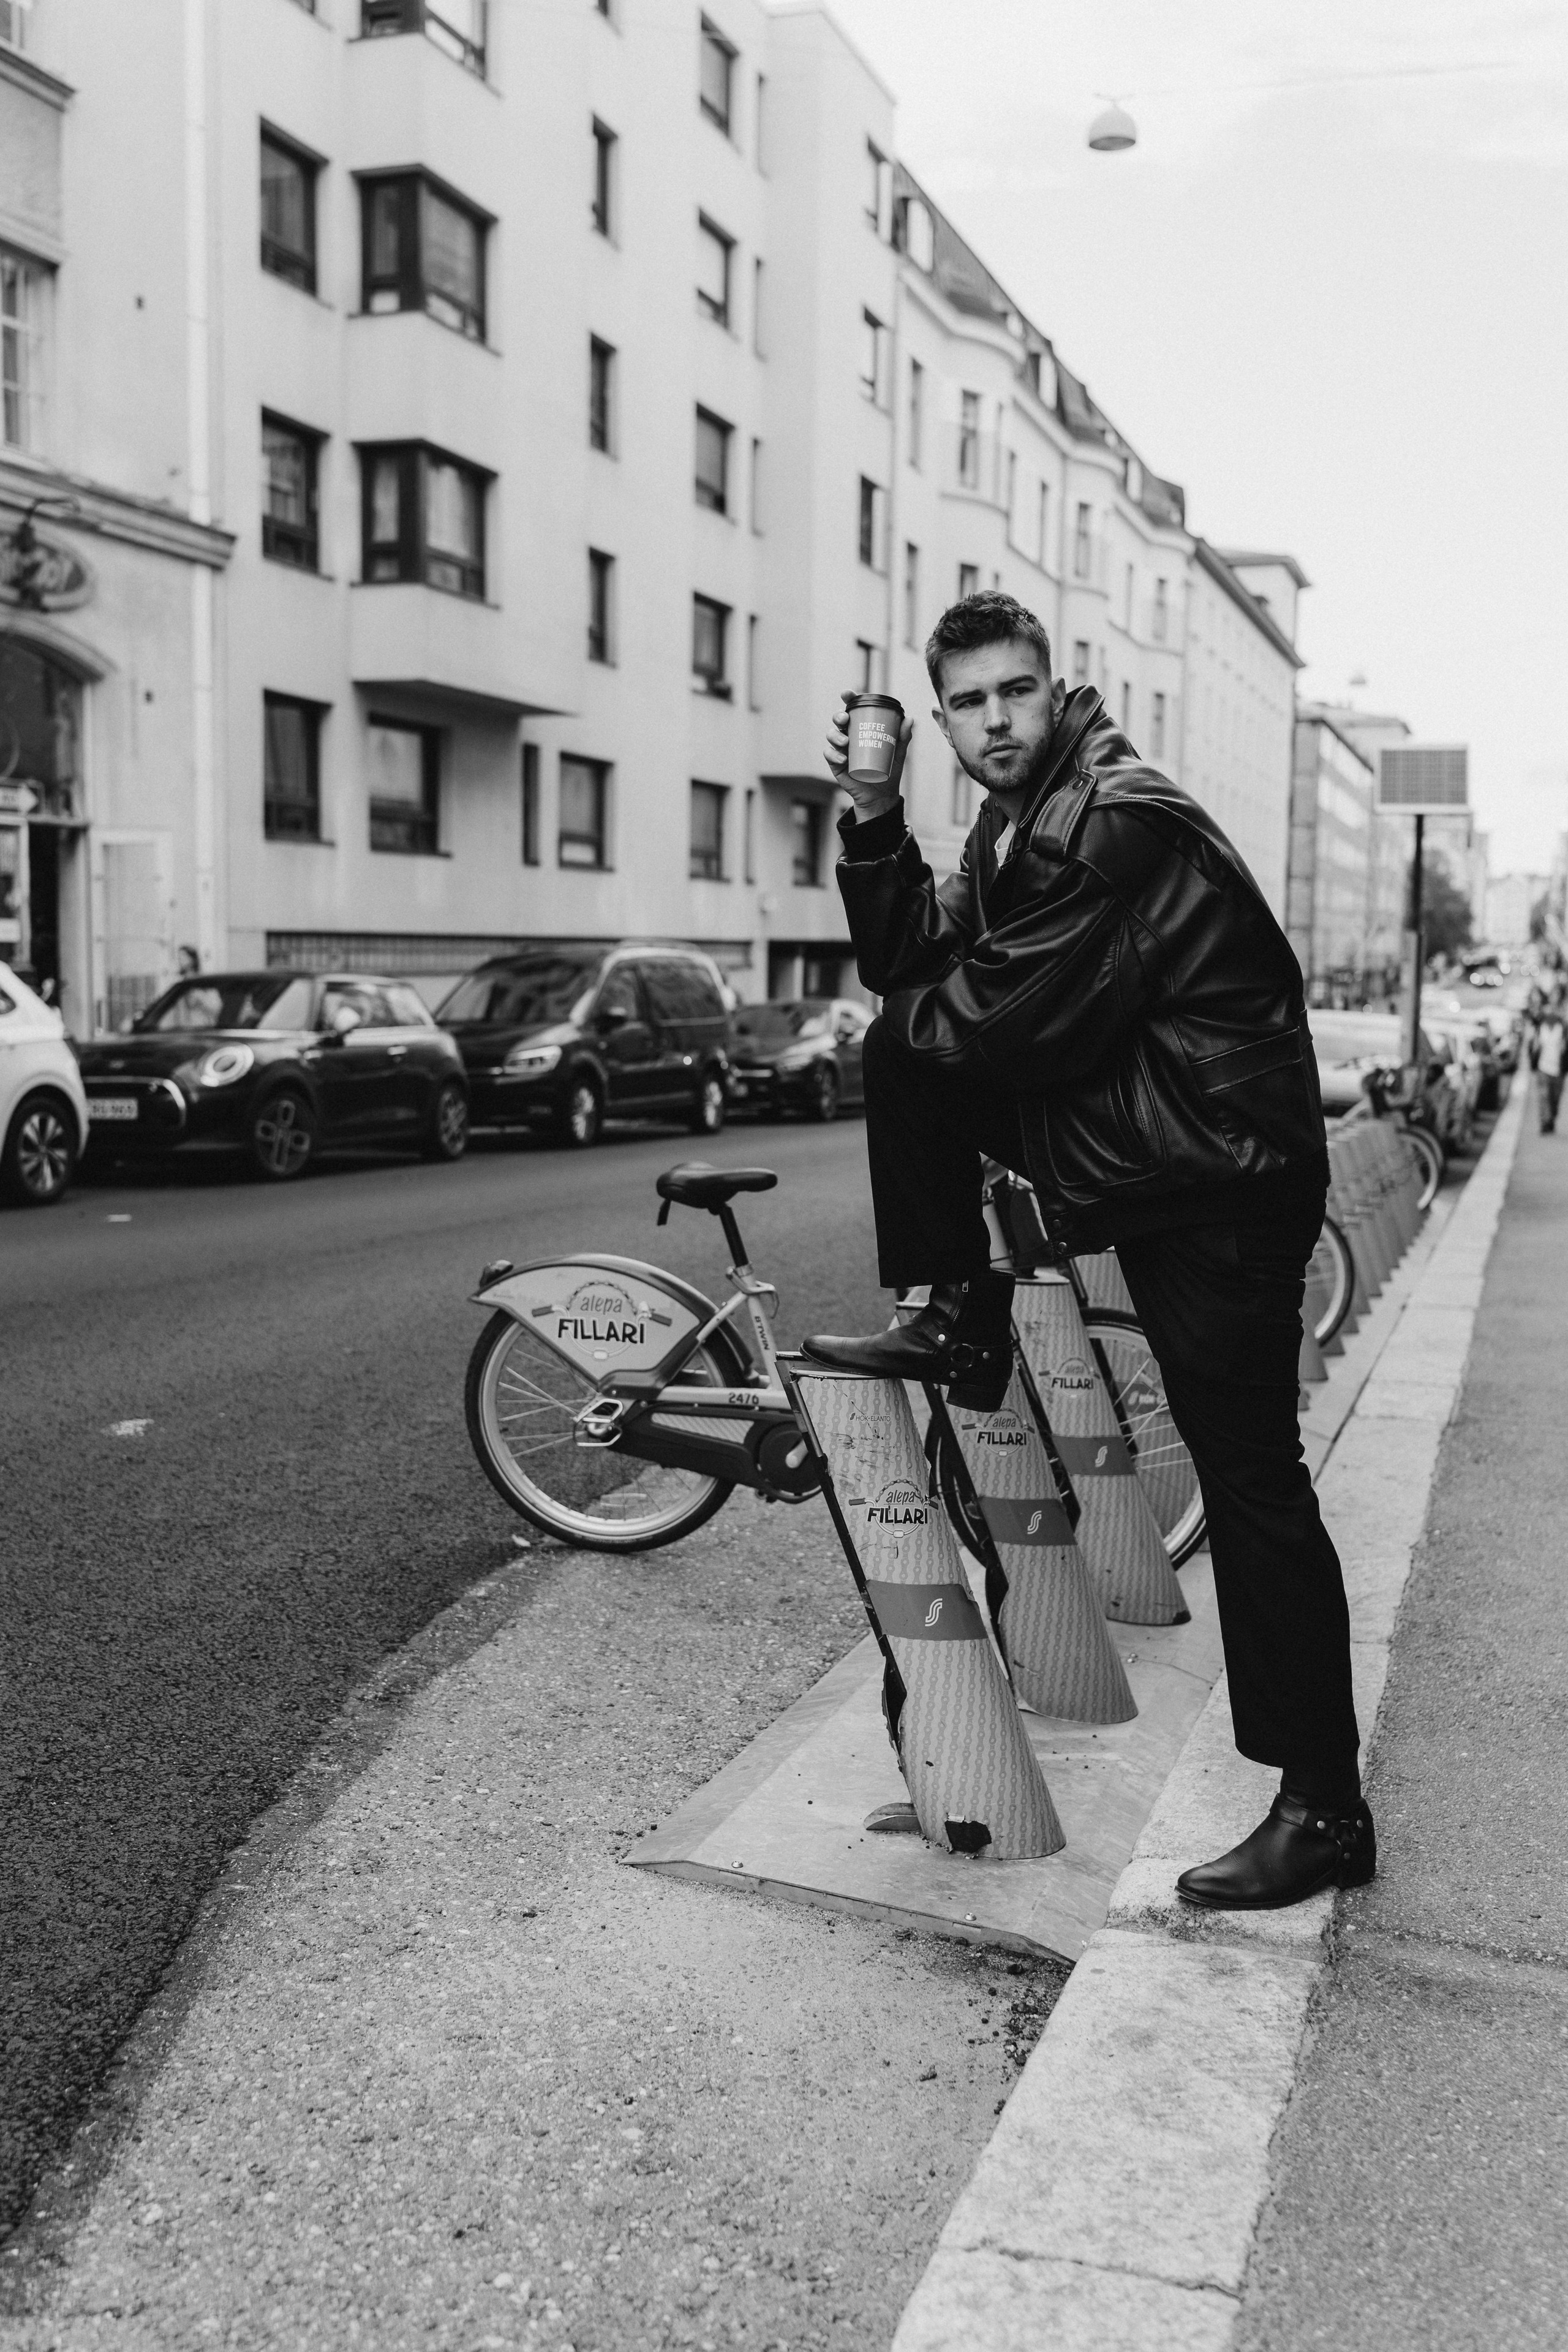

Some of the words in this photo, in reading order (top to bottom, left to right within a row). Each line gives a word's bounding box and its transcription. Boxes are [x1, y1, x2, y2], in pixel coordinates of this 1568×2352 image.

[859, 722, 886, 732] COFFEE
[859, 739, 883, 748] WOMEN
[581, 1295, 622, 1315] alepa
[558, 1319, 644, 1344] FILLARI
[1052, 1378, 1094, 1390] FILLARI
[729, 1392, 760, 1404] 2476
[992, 1417, 1017, 1430] alepa
[977, 1431, 1027, 1446] FILLARI
[886, 1490, 915, 1505] alepa
[867, 1507, 928, 1525] FILLARI
